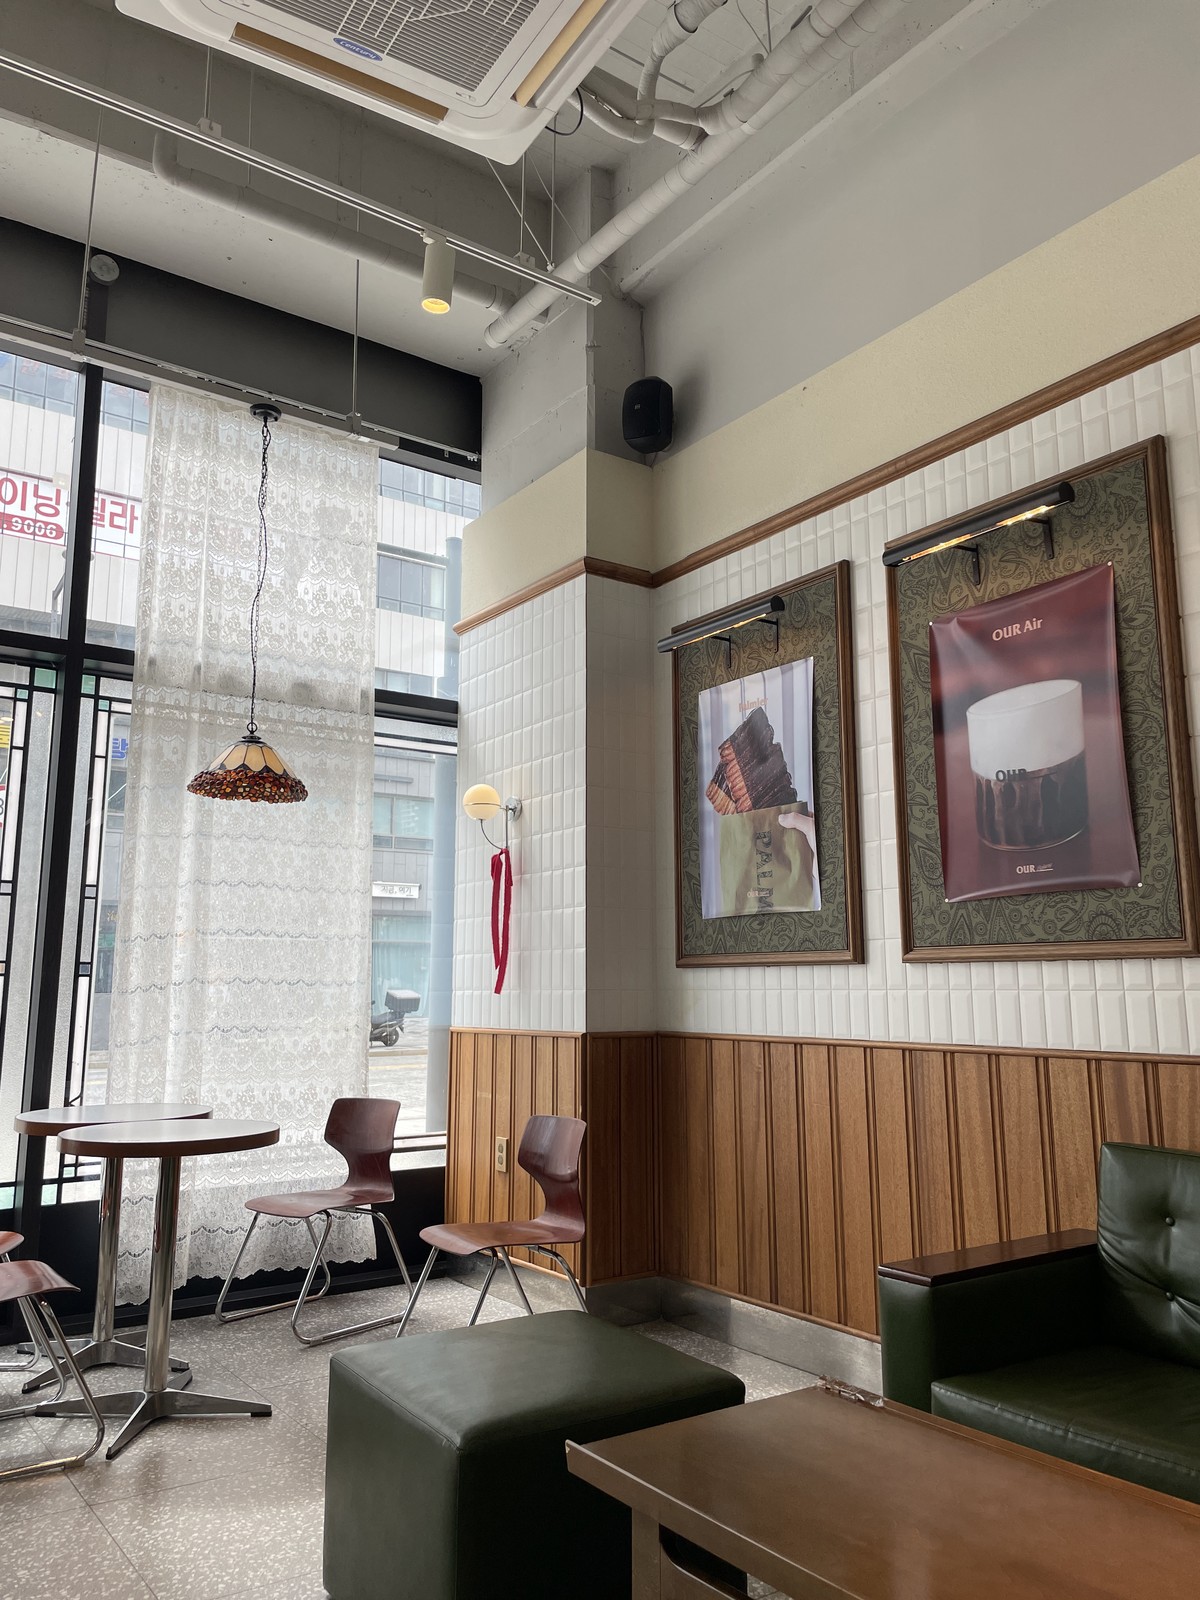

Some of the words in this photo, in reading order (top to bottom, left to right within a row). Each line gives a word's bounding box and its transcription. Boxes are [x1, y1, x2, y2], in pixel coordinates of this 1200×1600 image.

[992, 623, 1022, 641] OUR
[1023, 617, 1043, 633] Air
[1016, 864, 1036, 874] OUR
